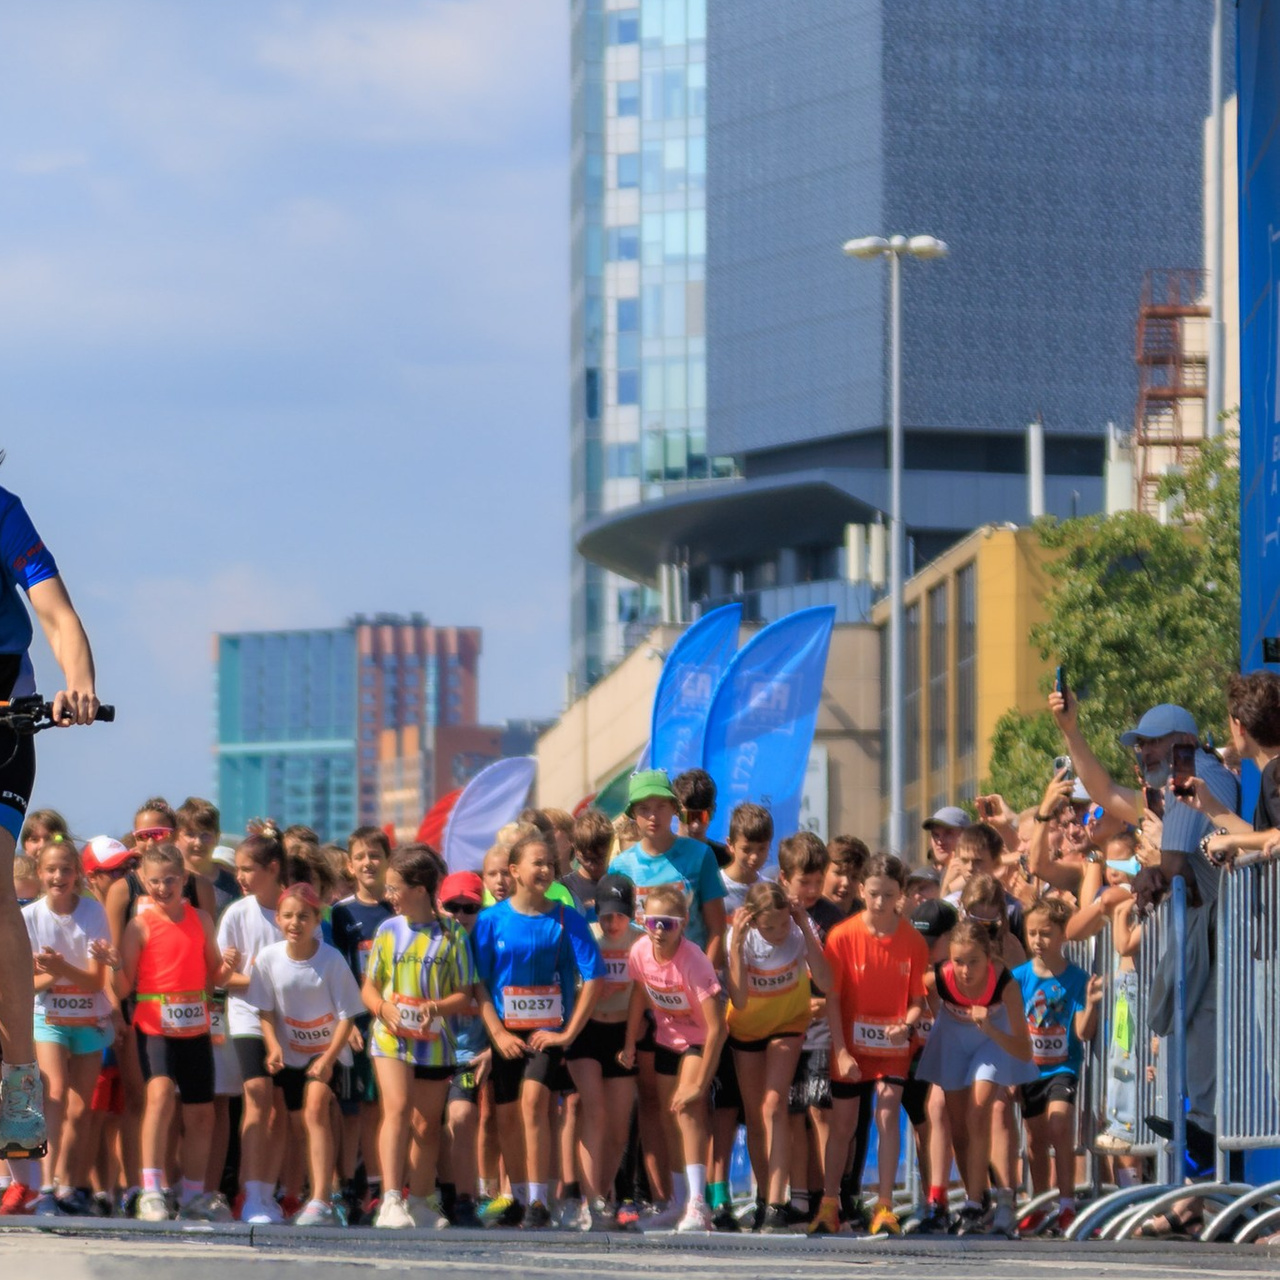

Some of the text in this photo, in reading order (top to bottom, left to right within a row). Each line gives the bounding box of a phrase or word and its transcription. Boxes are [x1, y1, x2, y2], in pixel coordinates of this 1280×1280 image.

[732, 741, 758, 792] 1723
[606, 962, 626, 974] 117
[750, 971, 794, 987] 10392
[52, 997, 93, 1010] 10025
[511, 998, 554, 1011] 10237
[167, 1006, 205, 1019] 10022
[292, 1028, 331, 1041] 10196
[861, 1027, 889, 1041] 103
[1034, 1039, 1063, 1050] 020
